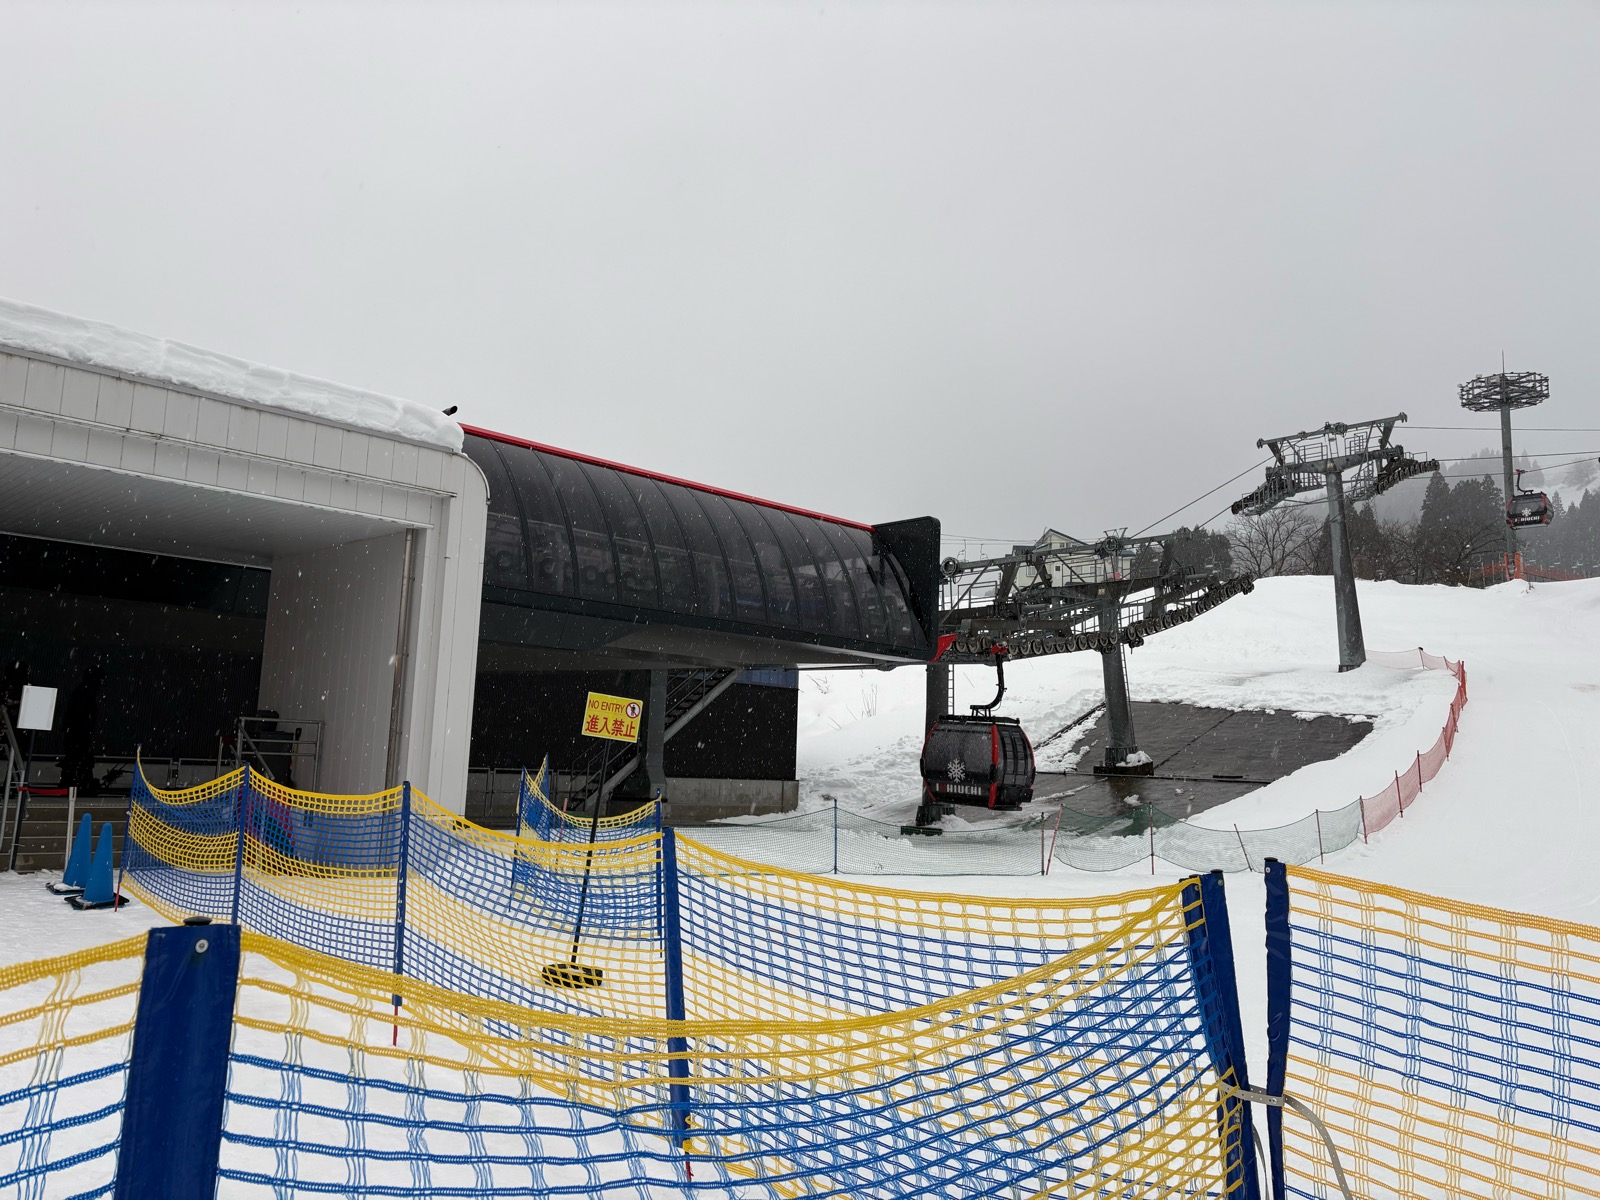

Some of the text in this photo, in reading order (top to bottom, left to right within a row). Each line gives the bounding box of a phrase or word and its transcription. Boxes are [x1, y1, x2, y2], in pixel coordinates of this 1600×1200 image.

[588, 700, 626, 714] NO ENTRY
[585, 714, 636, 738] 進入禁止
[946, 784, 982, 796] HIUCHI
